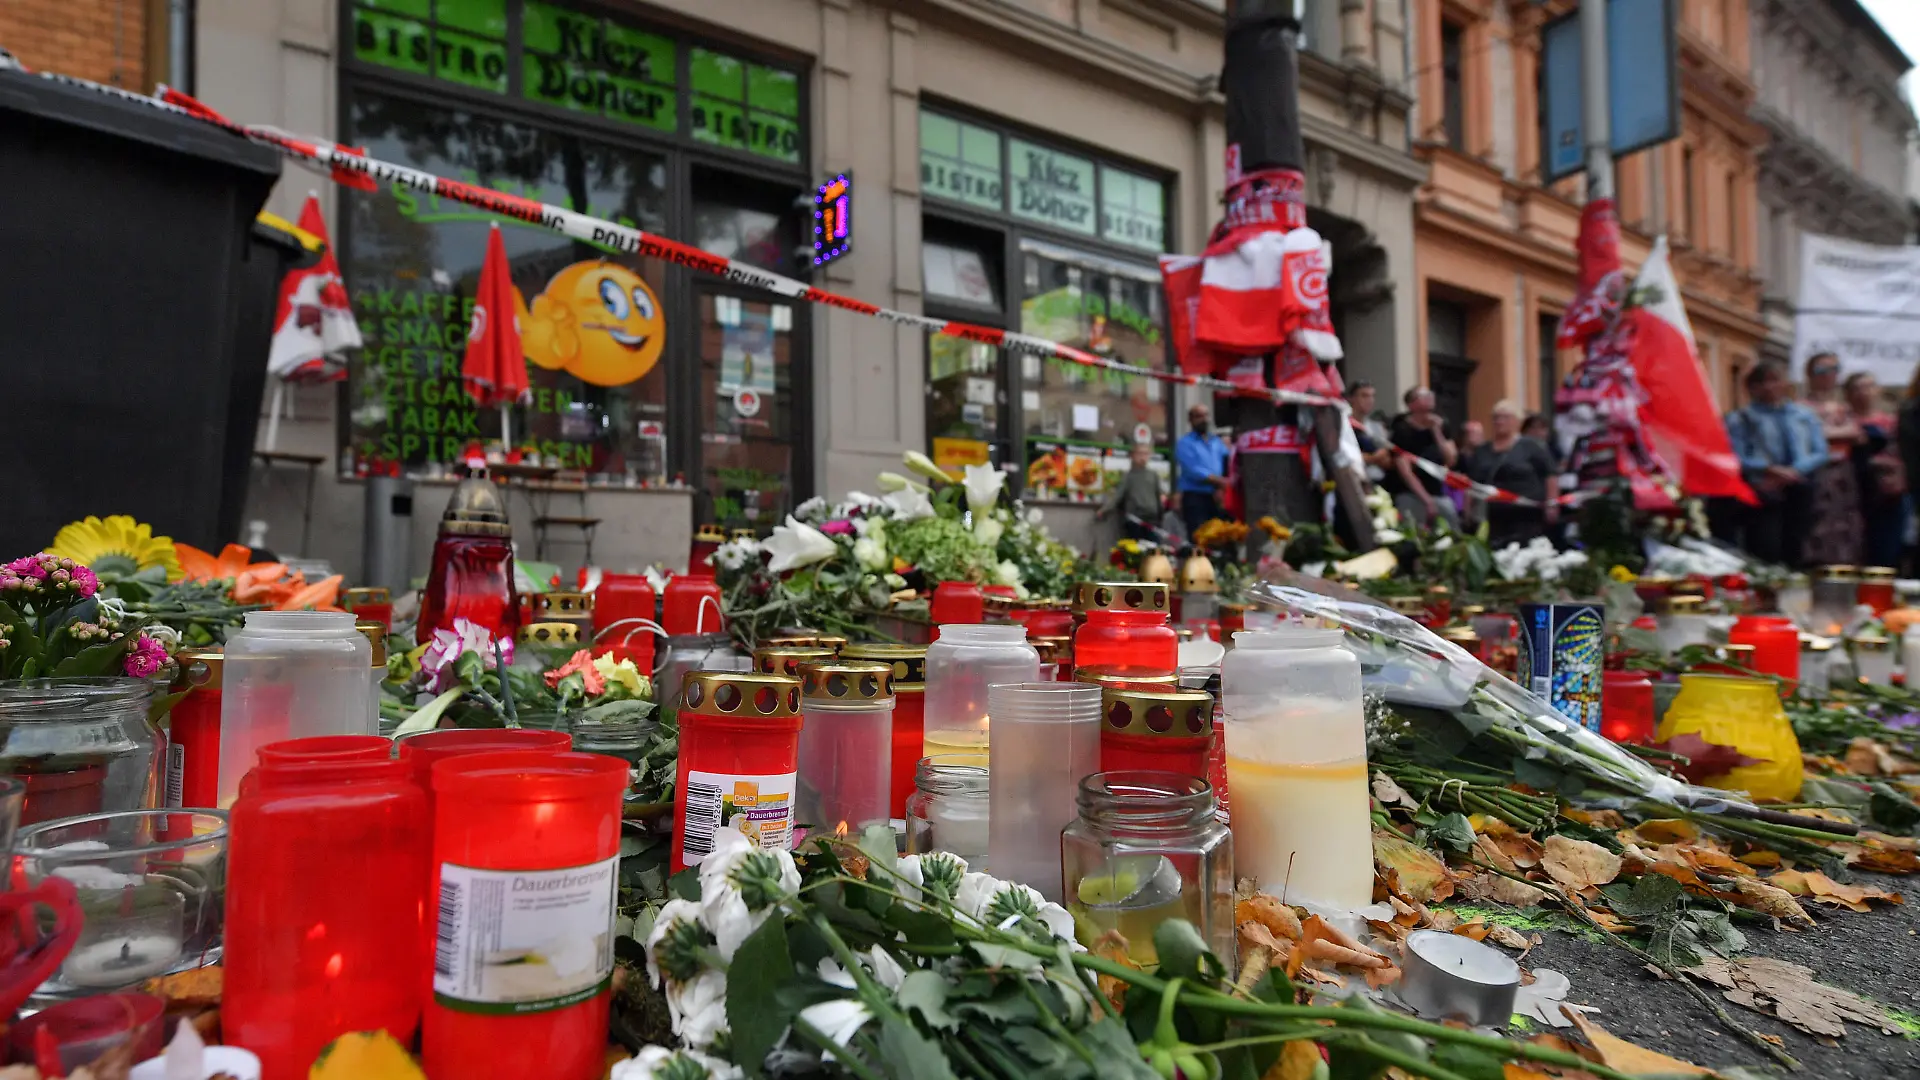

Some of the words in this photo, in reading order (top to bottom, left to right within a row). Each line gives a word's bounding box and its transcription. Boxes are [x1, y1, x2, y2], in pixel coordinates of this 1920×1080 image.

[357, 18, 504, 81] BISTRO
[555, 16, 652, 77] Kiez
[692, 104, 799, 156] BISTRO
[920, 161, 1001, 200] BISTRO
[1025, 151, 1081, 192] Kiez
[377, 288, 476, 323] KAFFE
[383, 316, 472, 353] SNAC
[385, 403, 482, 436] TABAK
